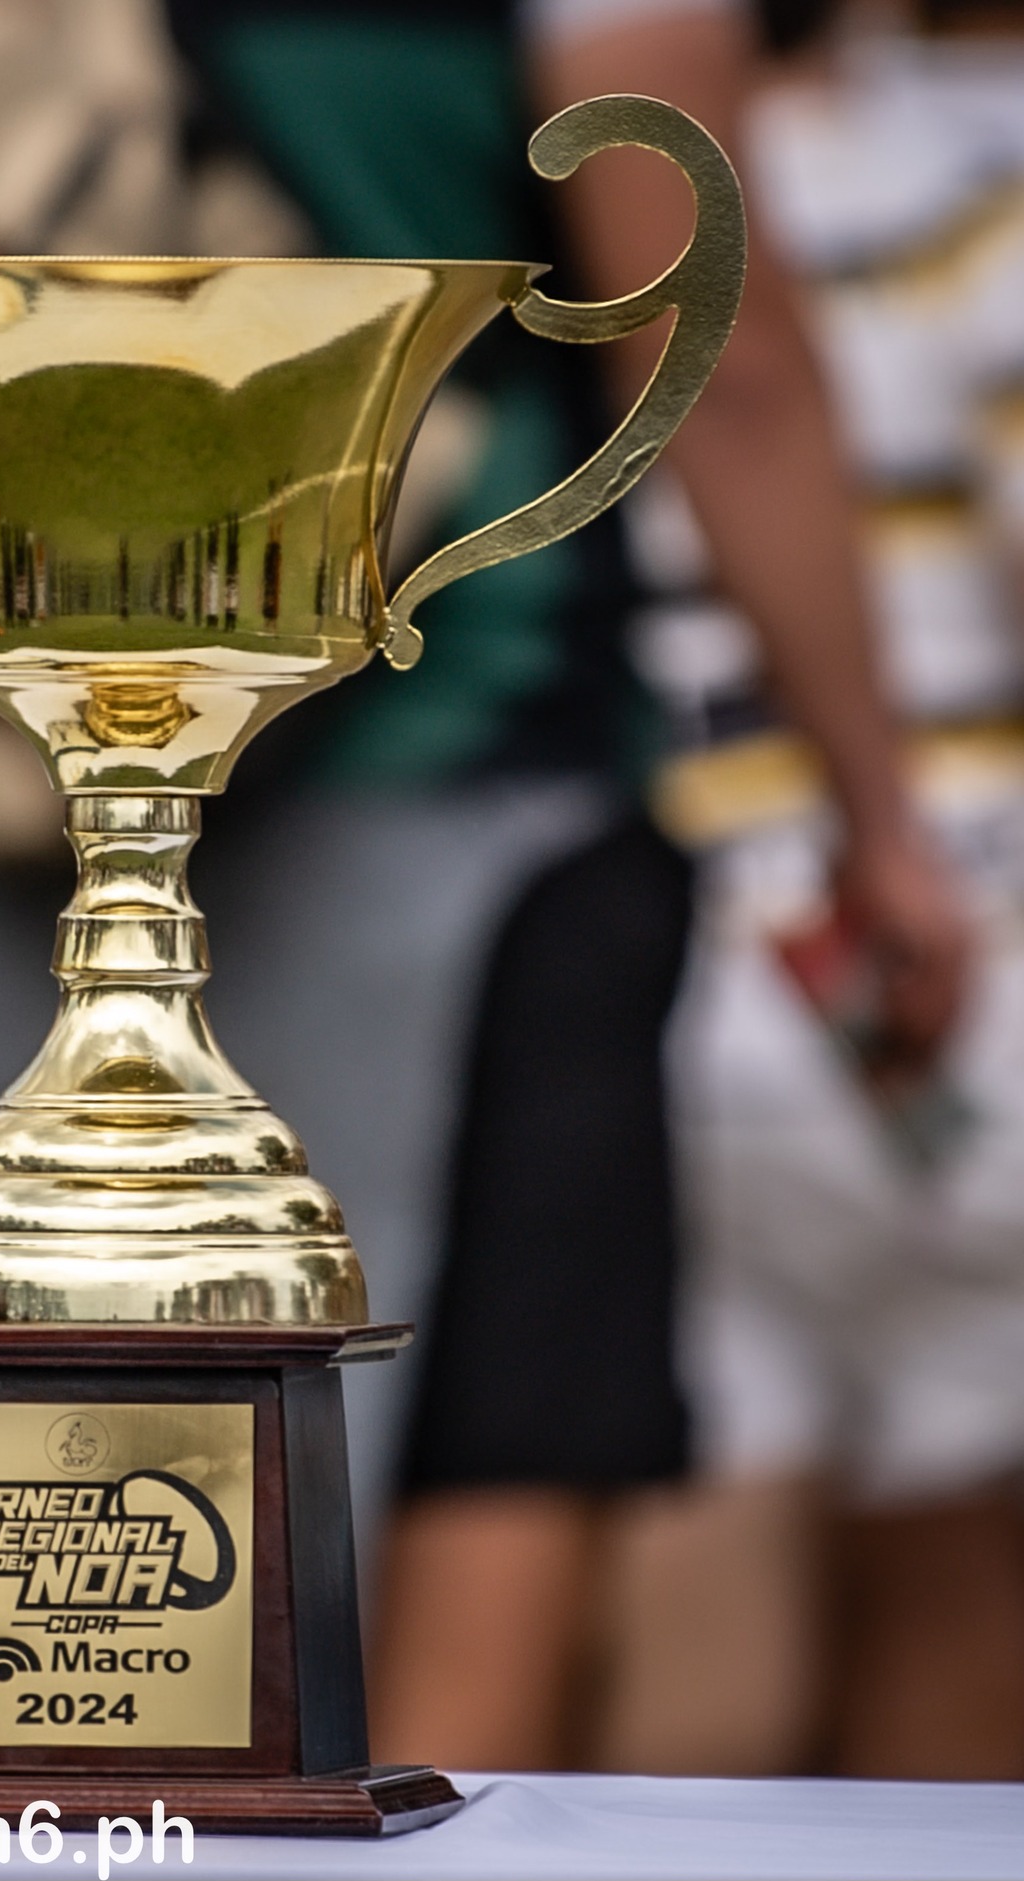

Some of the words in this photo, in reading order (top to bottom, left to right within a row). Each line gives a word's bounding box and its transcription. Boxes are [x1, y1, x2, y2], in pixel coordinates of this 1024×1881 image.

[24, 1553, 175, 1605] NOA
[44, 1615, 120, 1635] COPA
[51, 1641, 192, 1674] Macro
[15, 1693, 139, 1726] 2024
